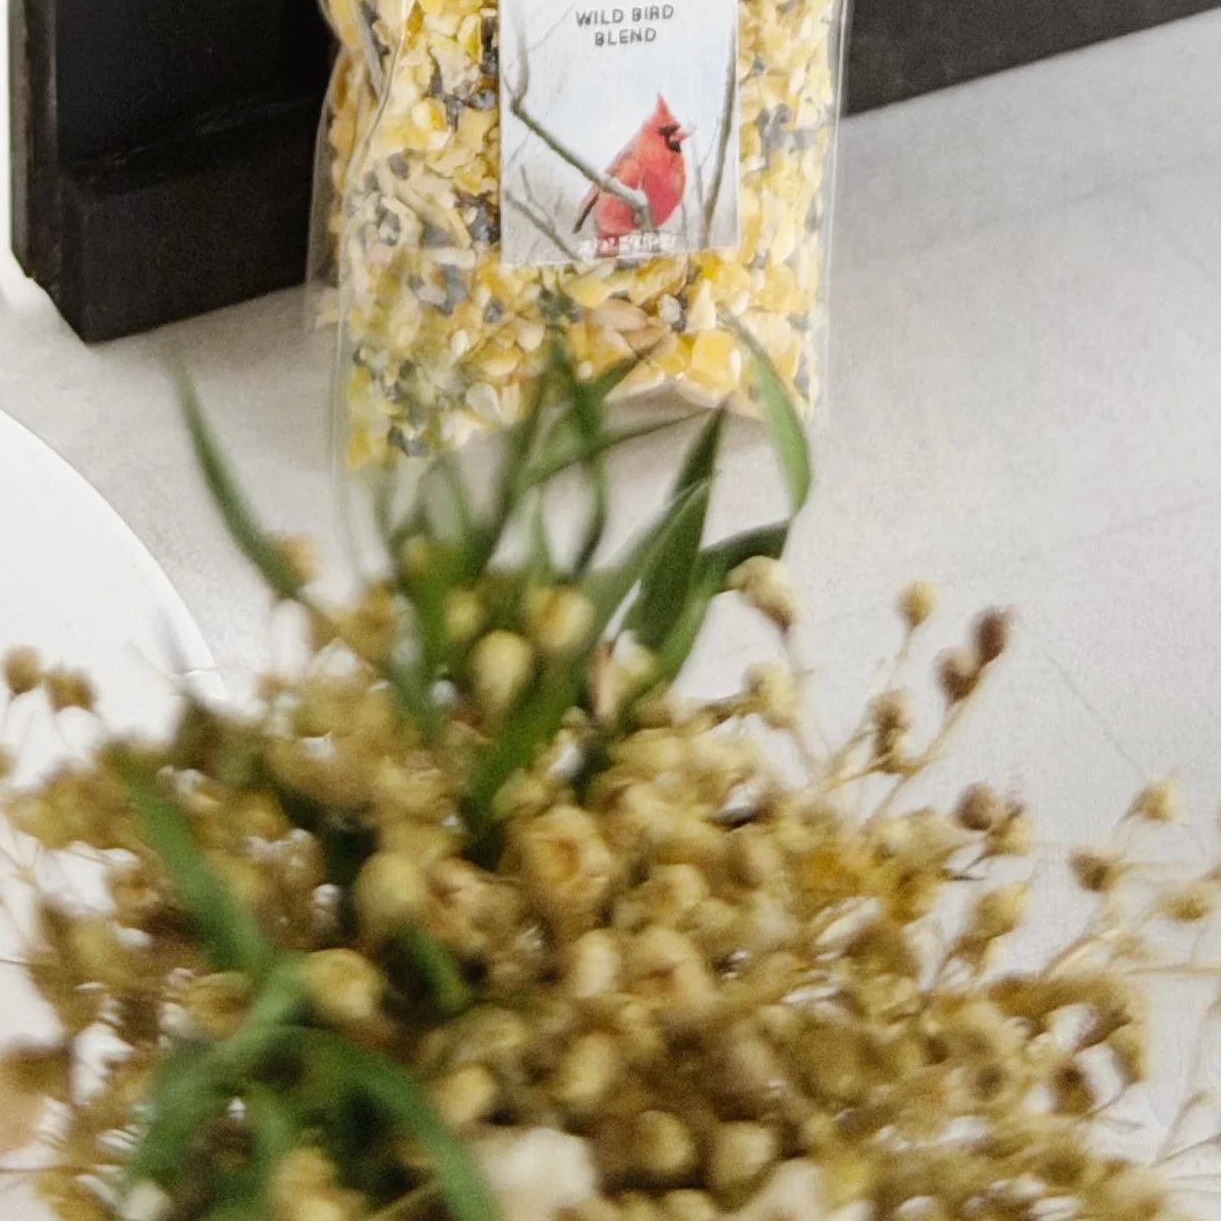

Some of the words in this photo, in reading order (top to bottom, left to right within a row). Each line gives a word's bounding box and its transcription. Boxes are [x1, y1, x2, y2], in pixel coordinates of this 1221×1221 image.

[576, 8, 624, 27] WILD
[632, 4, 675, 22] BIRD
[594, 27, 657, 46] BLEND
